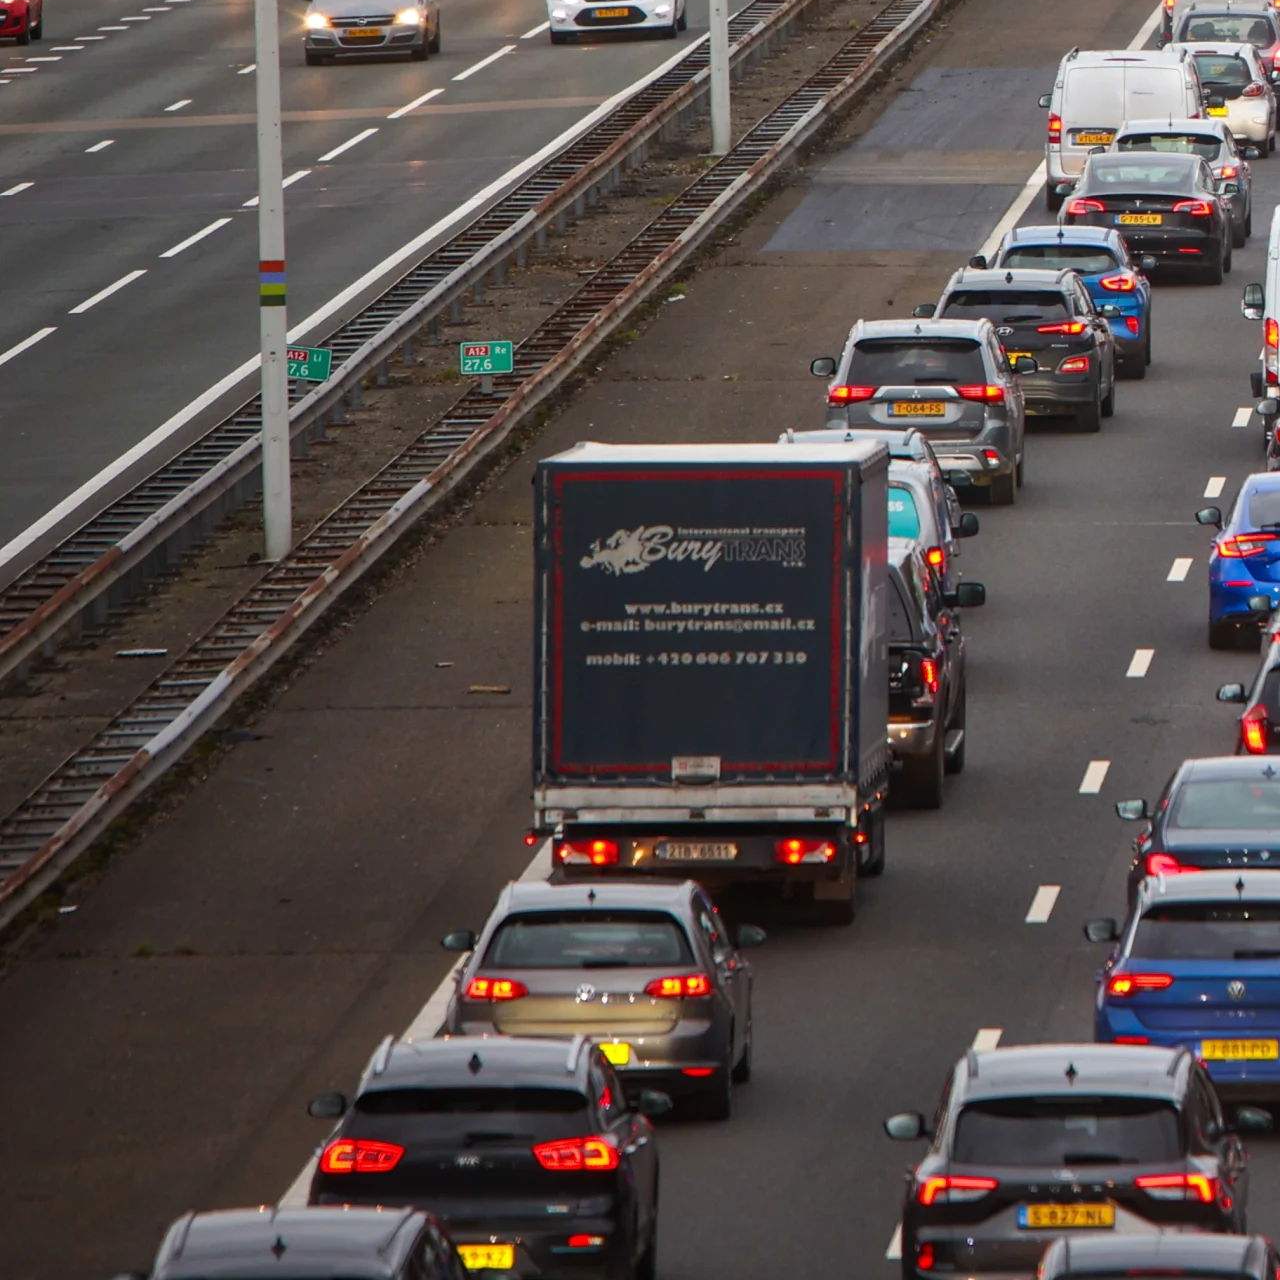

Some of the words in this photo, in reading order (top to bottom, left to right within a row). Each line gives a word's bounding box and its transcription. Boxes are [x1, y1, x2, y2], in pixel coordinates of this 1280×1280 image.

[287, 351, 304, 361] A12
[313, 353, 322, 363] Li
[468, 347, 486, 356] A12
[495, 346, 507, 355] Re
[288, 364, 309, 376] 7,6
[464, 359, 492, 372] 27,6
[896, 402, 942, 413] T-064-FS
[678, 527, 750, 536] International
[753, 527, 806, 537] transport
[625, 602, 784, 616] www.burytrans.cz
[580, 619, 640, 631] e-mail:
[644, 619, 816, 634] burytrans@email.cz
[586, 652, 641, 666] mobil:
[735, 651, 769, 664] 707
